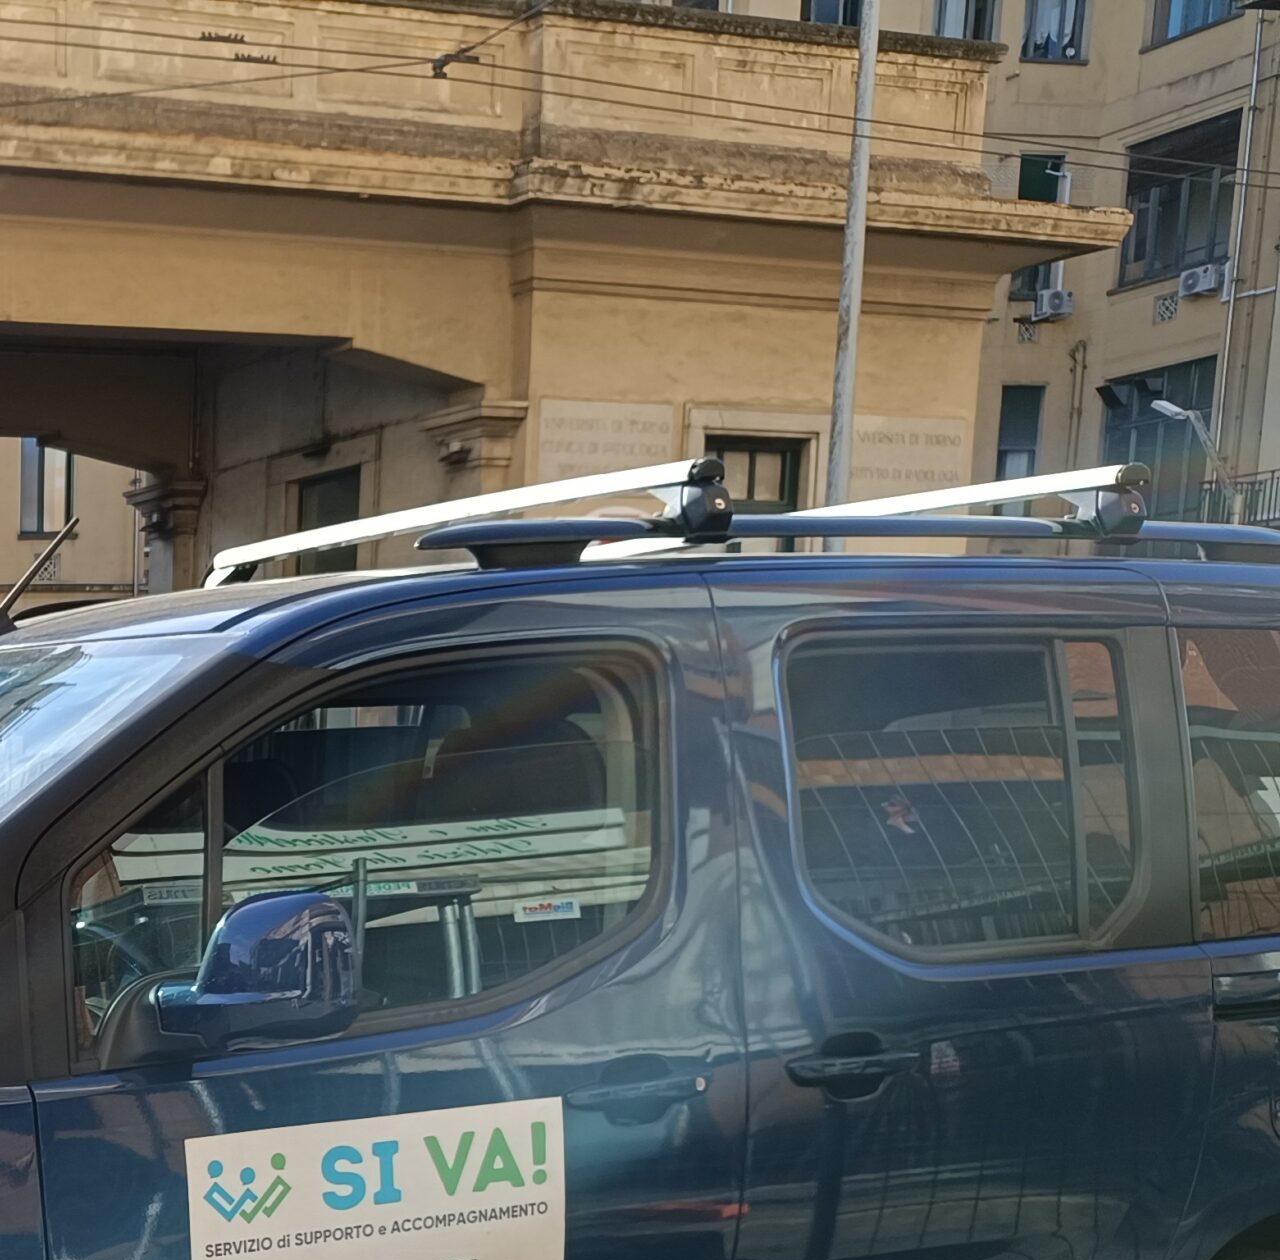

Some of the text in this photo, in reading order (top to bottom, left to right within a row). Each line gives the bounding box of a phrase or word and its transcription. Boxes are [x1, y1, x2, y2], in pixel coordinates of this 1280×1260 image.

[321, 1121, 548, 1210] SI VA!
[205, 1201, 548, 1258] SERVIZIO di SUPPORTO e ACCOMPAGNAMENTO
